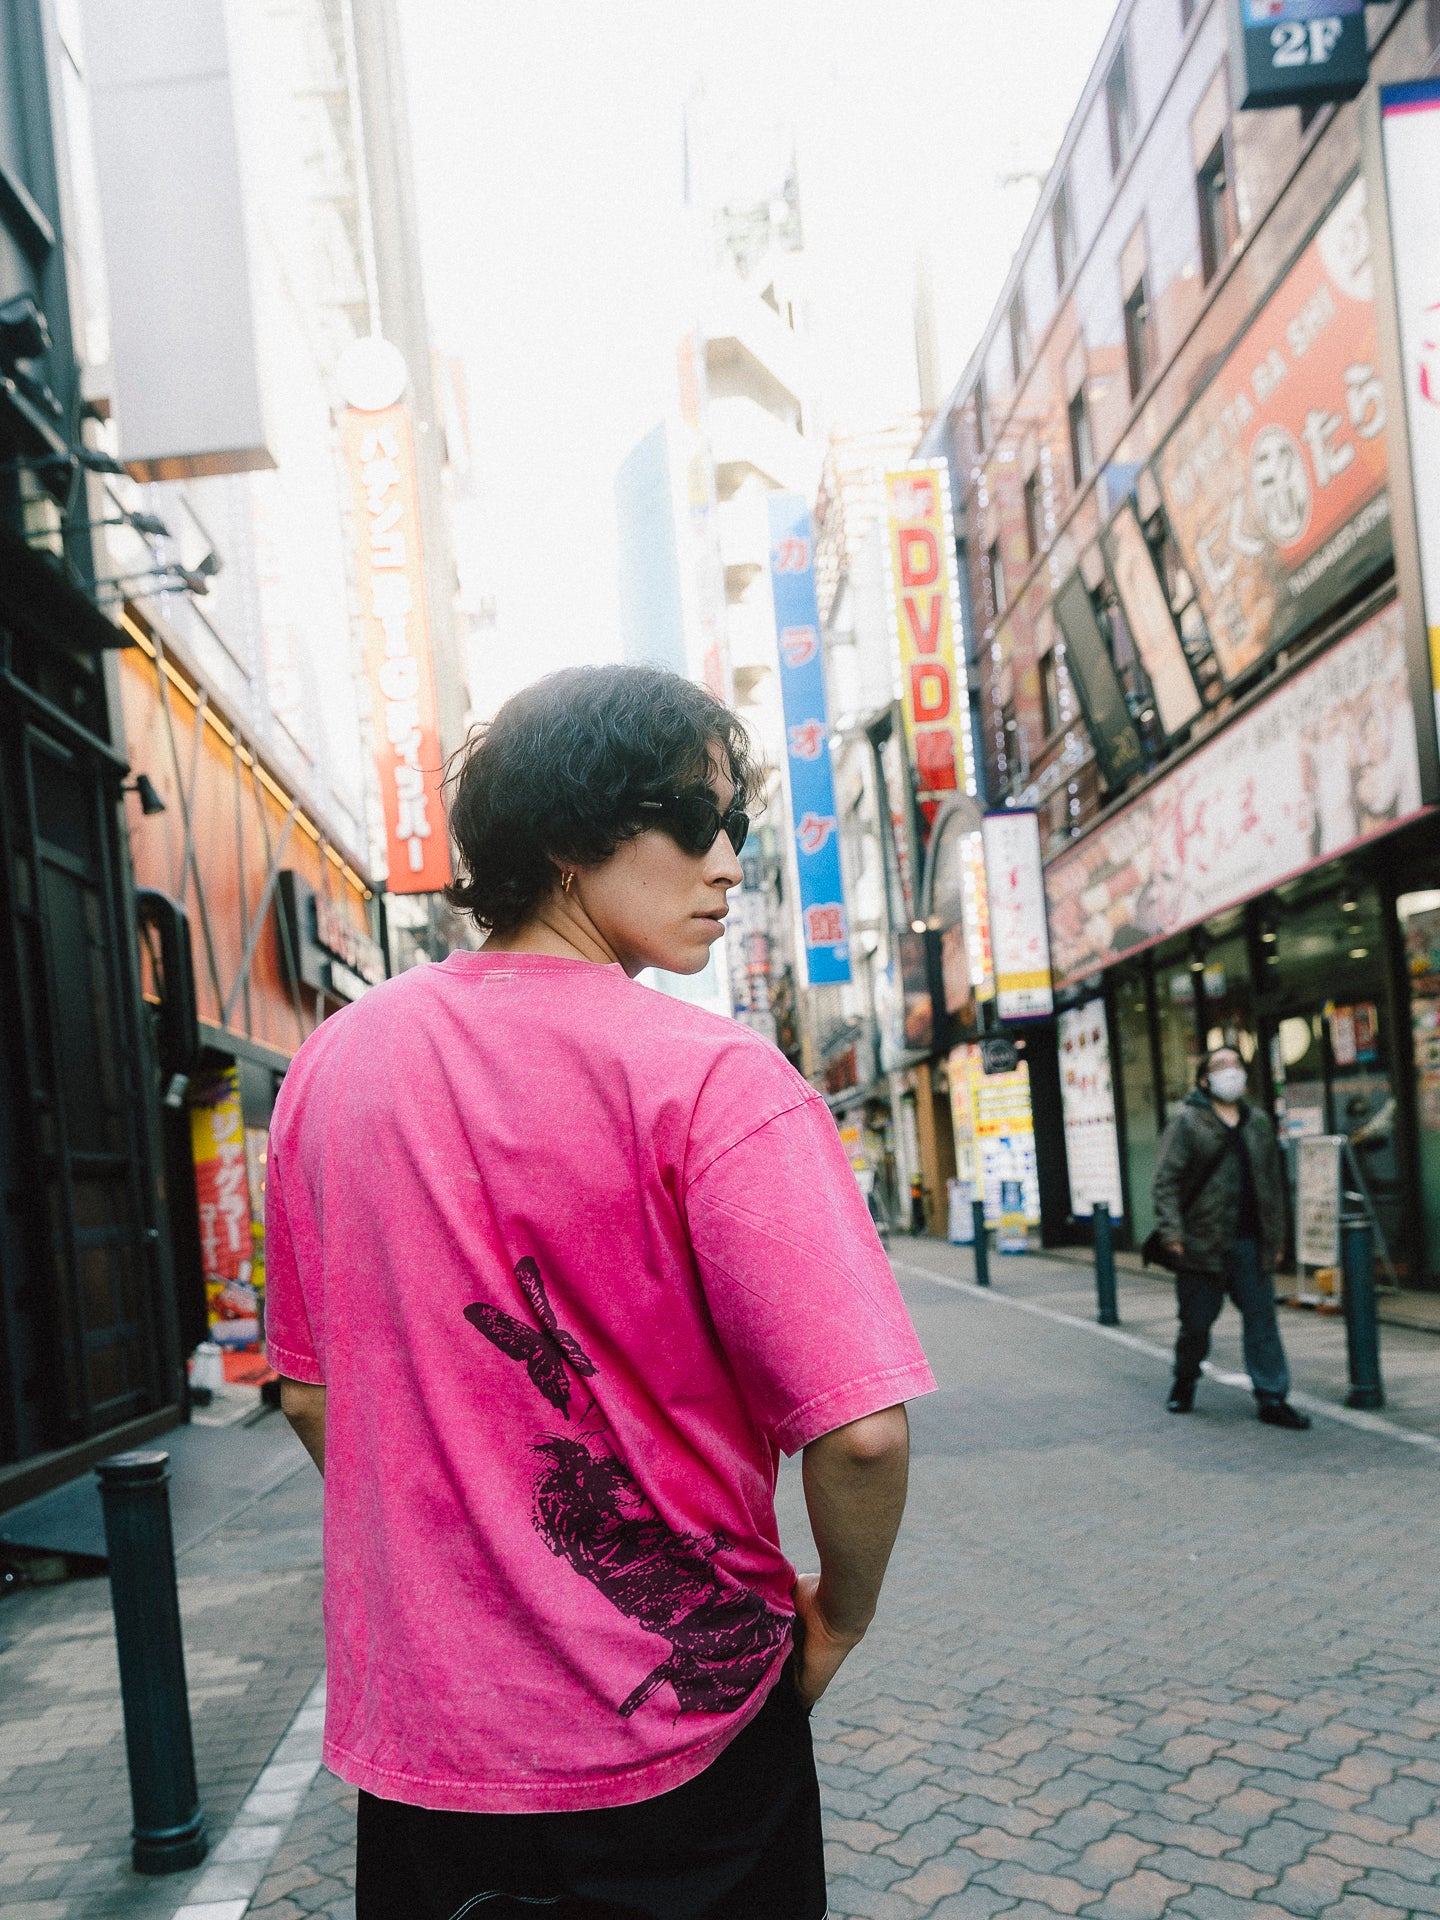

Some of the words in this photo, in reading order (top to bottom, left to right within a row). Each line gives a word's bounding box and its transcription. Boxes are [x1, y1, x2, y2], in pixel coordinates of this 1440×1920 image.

[1269, 16, 1343, 69] 2F
[776, 537, 846, 945] カラオケ館
